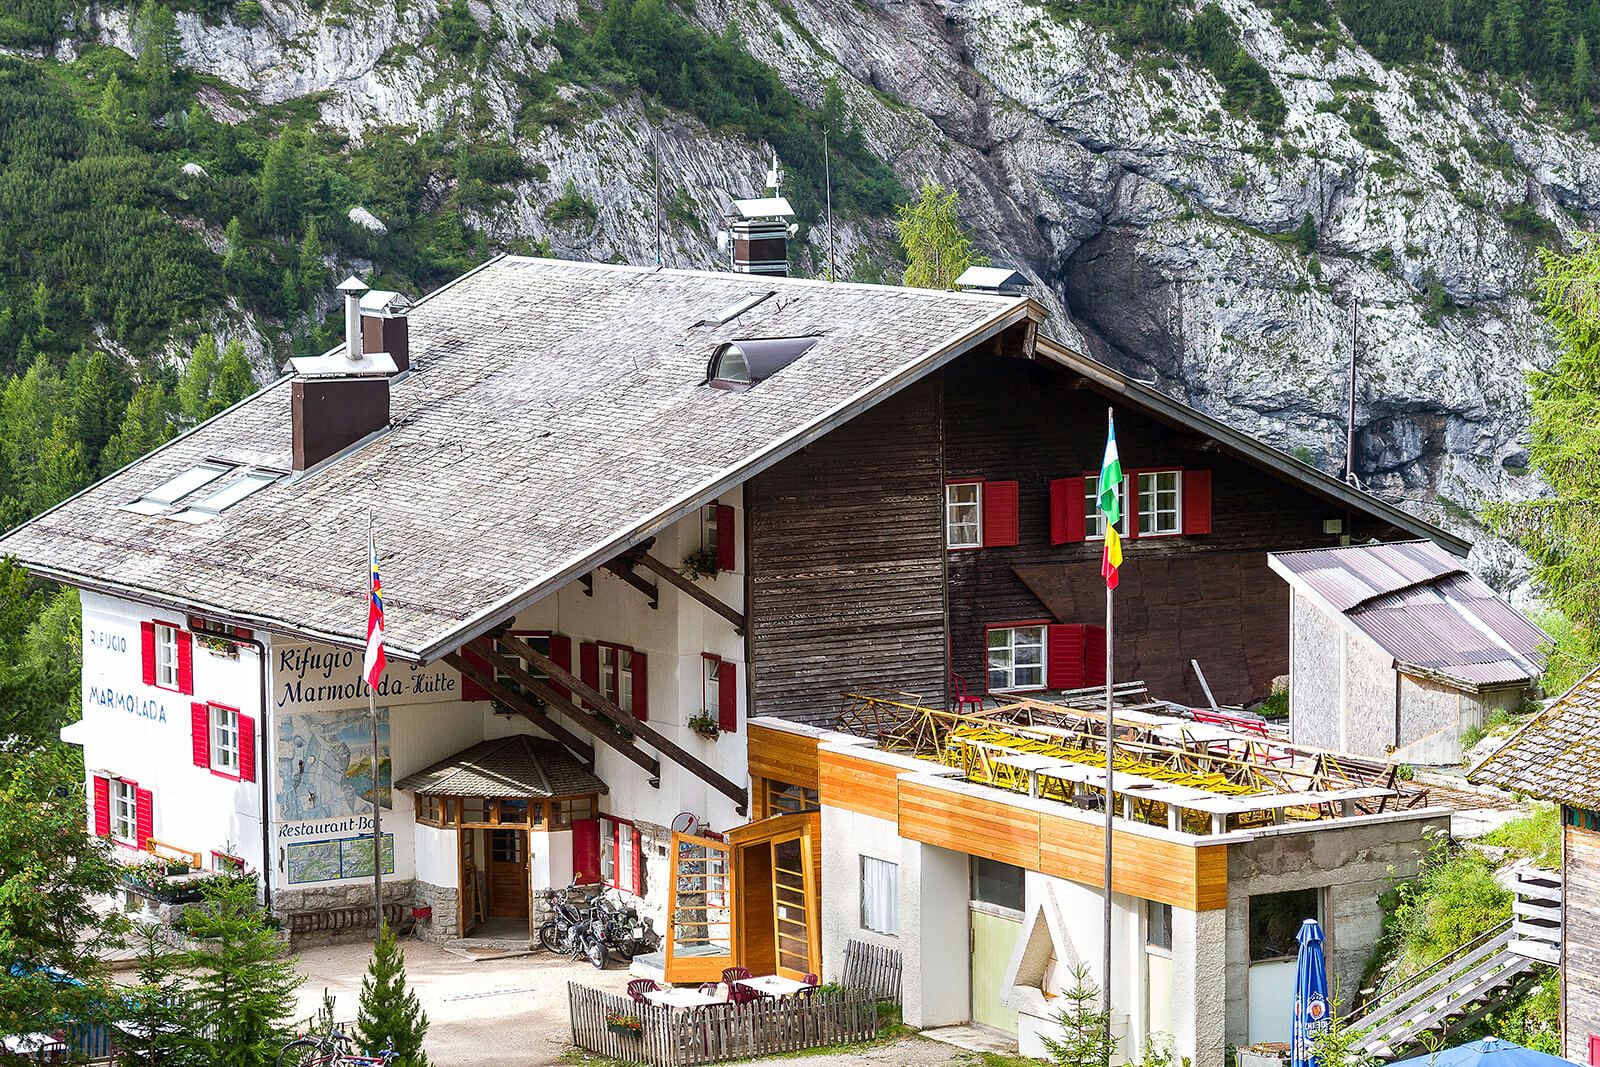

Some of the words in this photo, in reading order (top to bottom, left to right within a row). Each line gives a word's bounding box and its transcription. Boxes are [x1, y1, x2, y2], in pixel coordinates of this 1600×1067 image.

[279, 647, 352, 679] Rifugio
[89, 686, 167, 724] MARMOLADA
[278, 816, 383, 838] Restaurant-Ba
